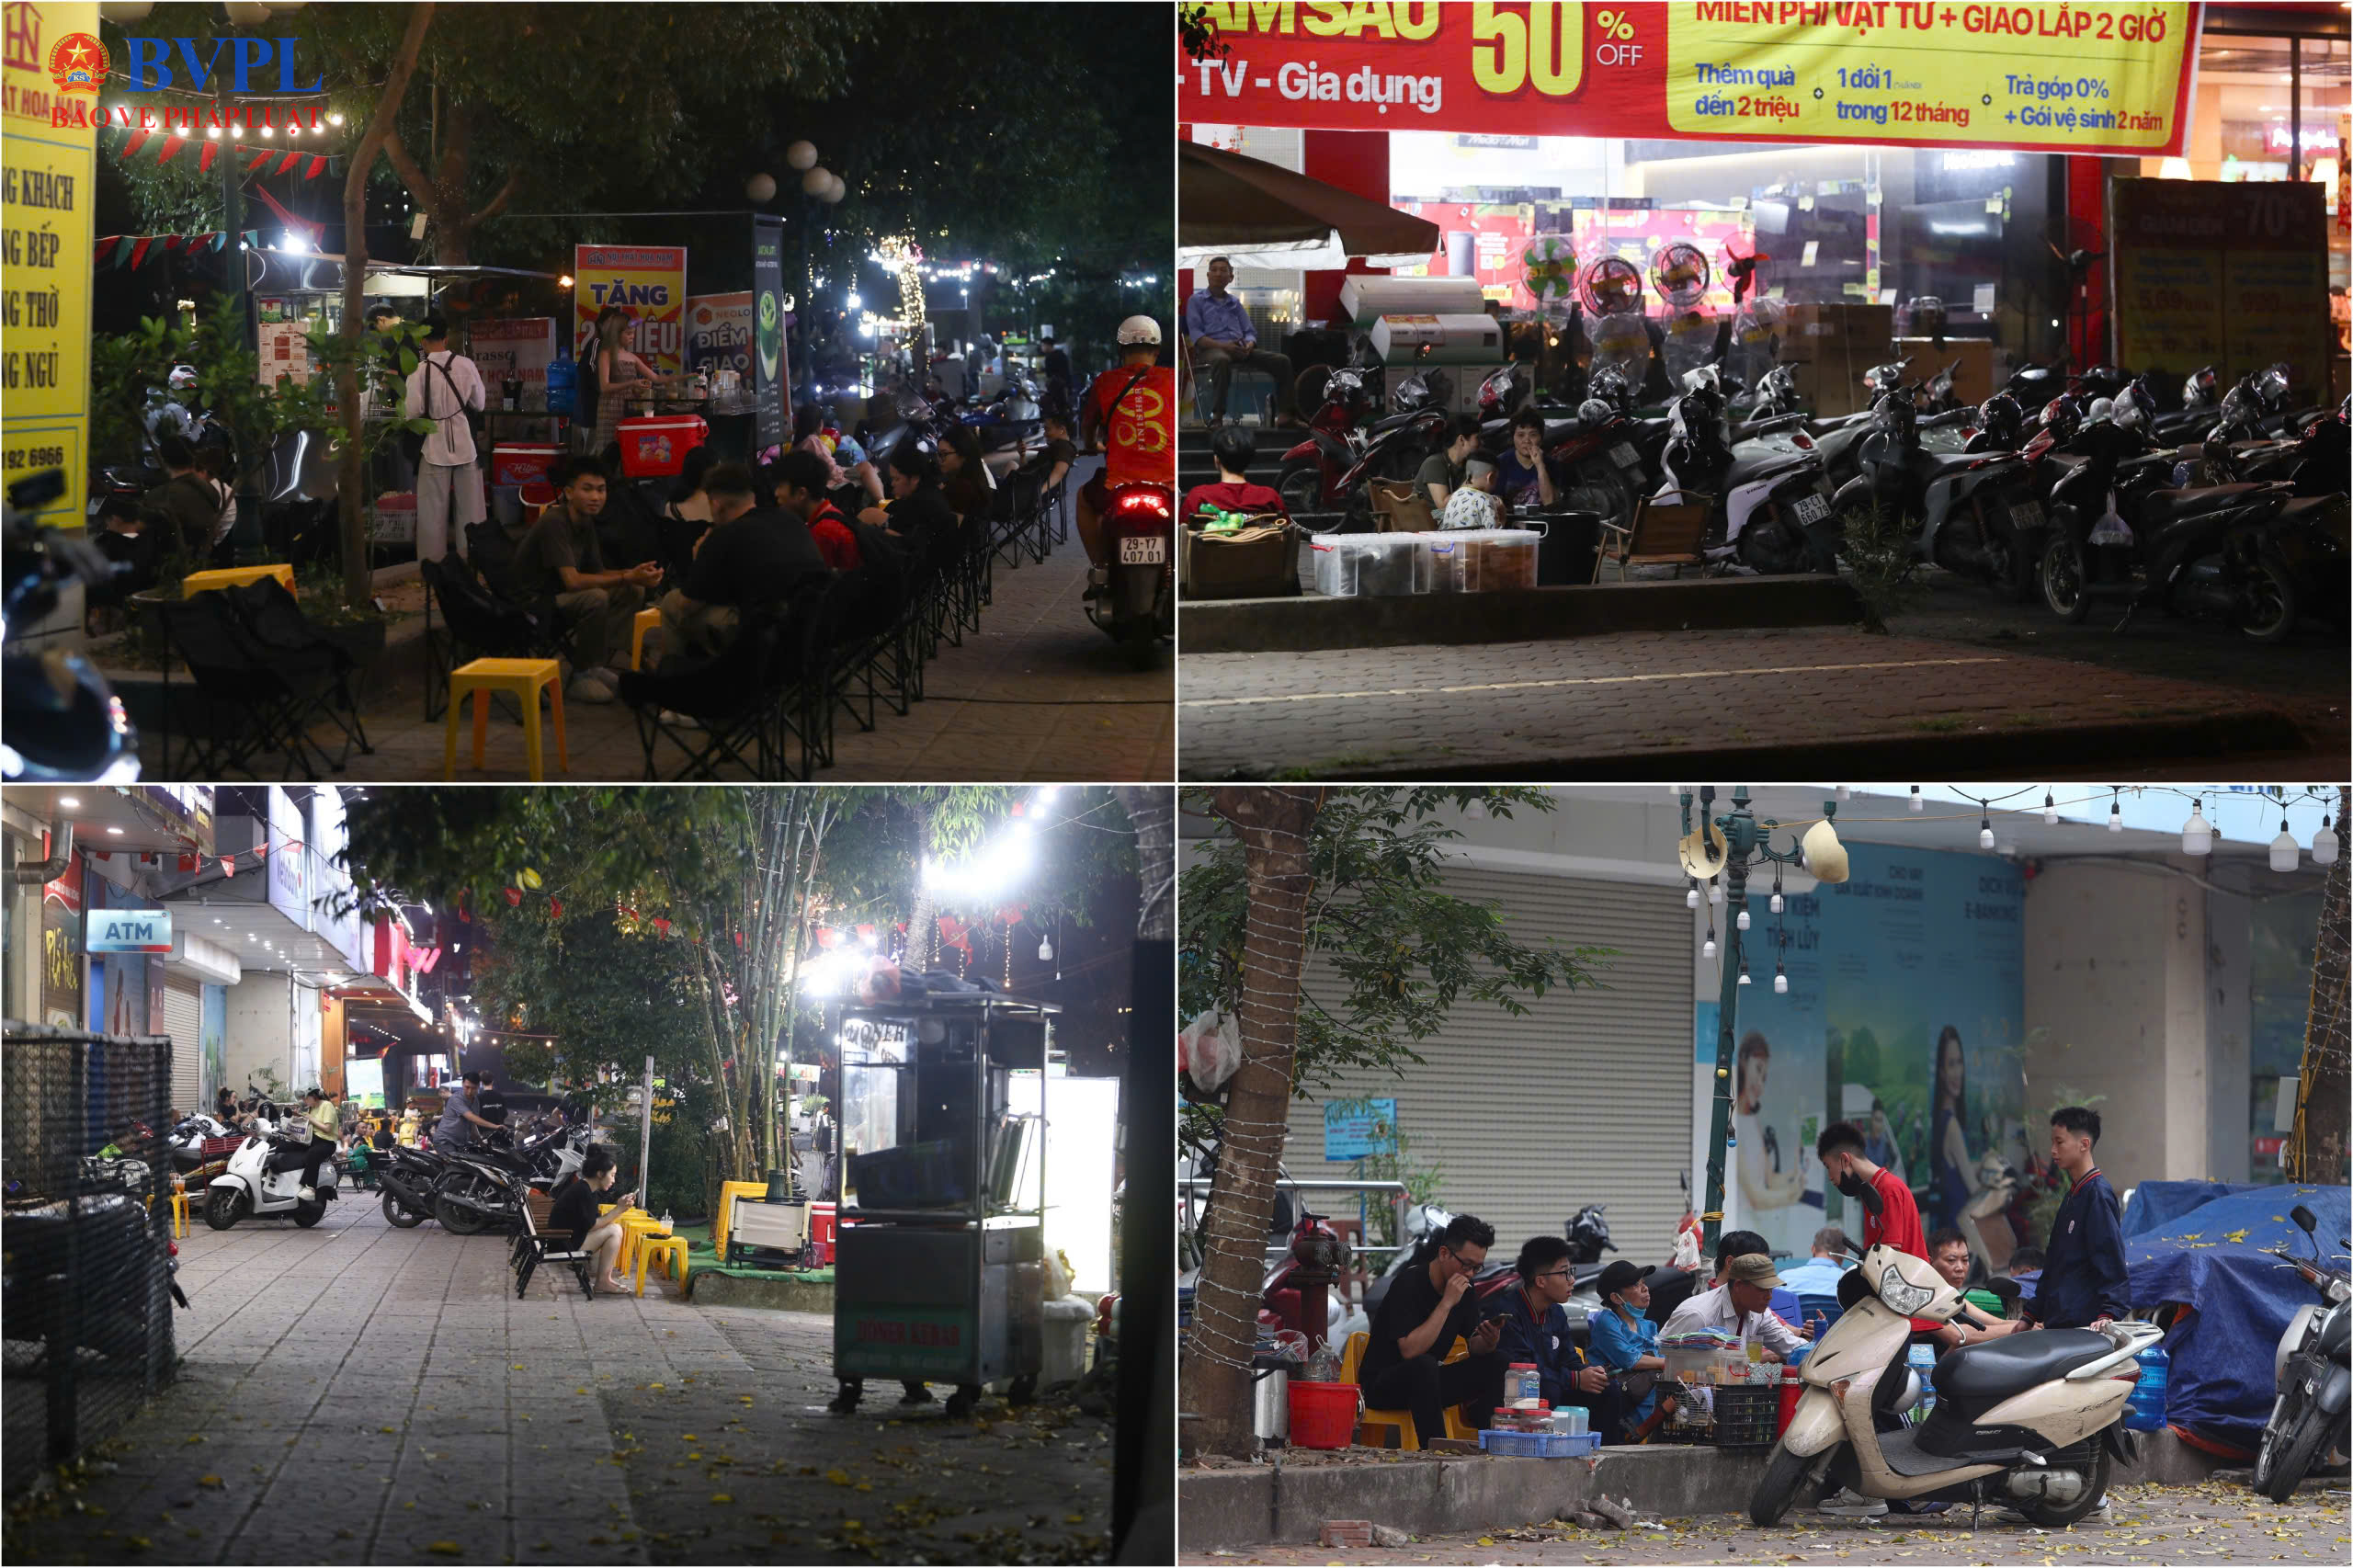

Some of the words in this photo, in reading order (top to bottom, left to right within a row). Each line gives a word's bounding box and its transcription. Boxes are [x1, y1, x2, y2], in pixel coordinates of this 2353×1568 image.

[1597, 10, 1634, 40] %
[1963, 5, 2033, 36] GIAO
[2039, 2, 2092, 38] LẮP
[2097, 13, 2113, 40] 2
[2119, 7, 2166, 43] GIỜ
[1472, 2, 1584, 96] 50
[1597, 43, 1643, 66] OFF
[1192, 59, 1247, 97] TV
[1279, 61, 1340, 100] Gia
[1346, 66, 1441, 113] dụng
[1695, 62, 1754, 85] Thêm
[1757, 64, 1795, 90] quà
[1837, 68, 1847, 87] 1
[1883, 70, 1892, 89] 1
[2006, 74, 2034, 95] Trả
[2038, 75, 2073, 100] góp
[2076, 78, 2109, 98] 0%
[1695, 90, 1735, 117] đến
[1737, 96, 1751, 117] 2
[1754, 96, 1800, 123] triệu
[1836, 100, 1887, 124] trong
[1891, 101, 1912, 121] 12
[1915, 101, 1970, 128] tháng
[2021, 106, 2052, 126] Gói
[2054, 108, 2076, 132] vệ
[2080, 109, 2116, 130] sinh
[2118, 111, 2127, 129] 2
[2130, 111, 2163, 131] năm
[21, 164, 74, 211] KHÁCH
[28, 221, 60, 268] BẾP
[27, 284, 59, 328] THỜ
[698, 322, 748, 349] ĐIỂM
[25, 342, 59, 389] NGỦ
[1126, 538, 1157, 551] 29-Y7
[105, 922, 153, 941] ATM
